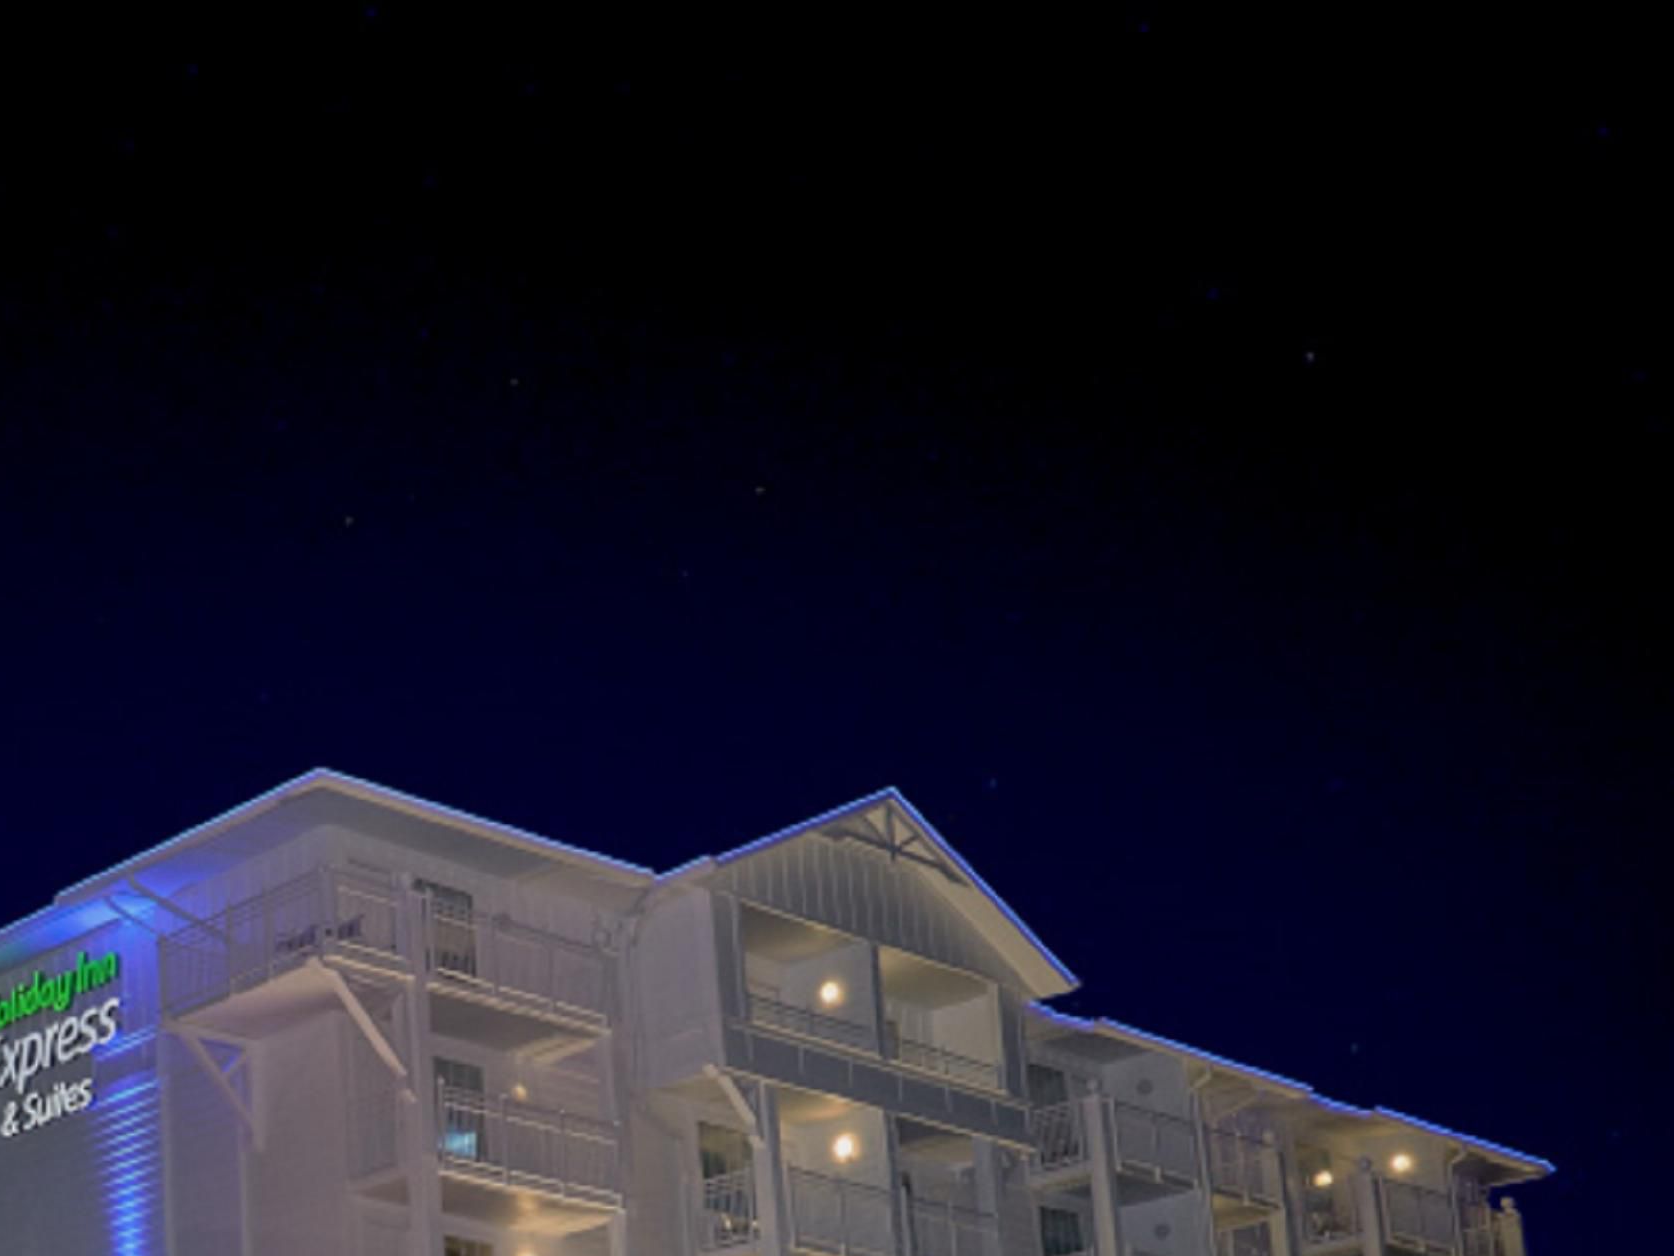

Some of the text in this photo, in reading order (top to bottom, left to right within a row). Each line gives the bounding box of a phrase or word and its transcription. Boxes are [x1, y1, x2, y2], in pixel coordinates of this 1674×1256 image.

[76, 951, 117, 993] Inn
[0, 1078, 93, 1137] & Suites
